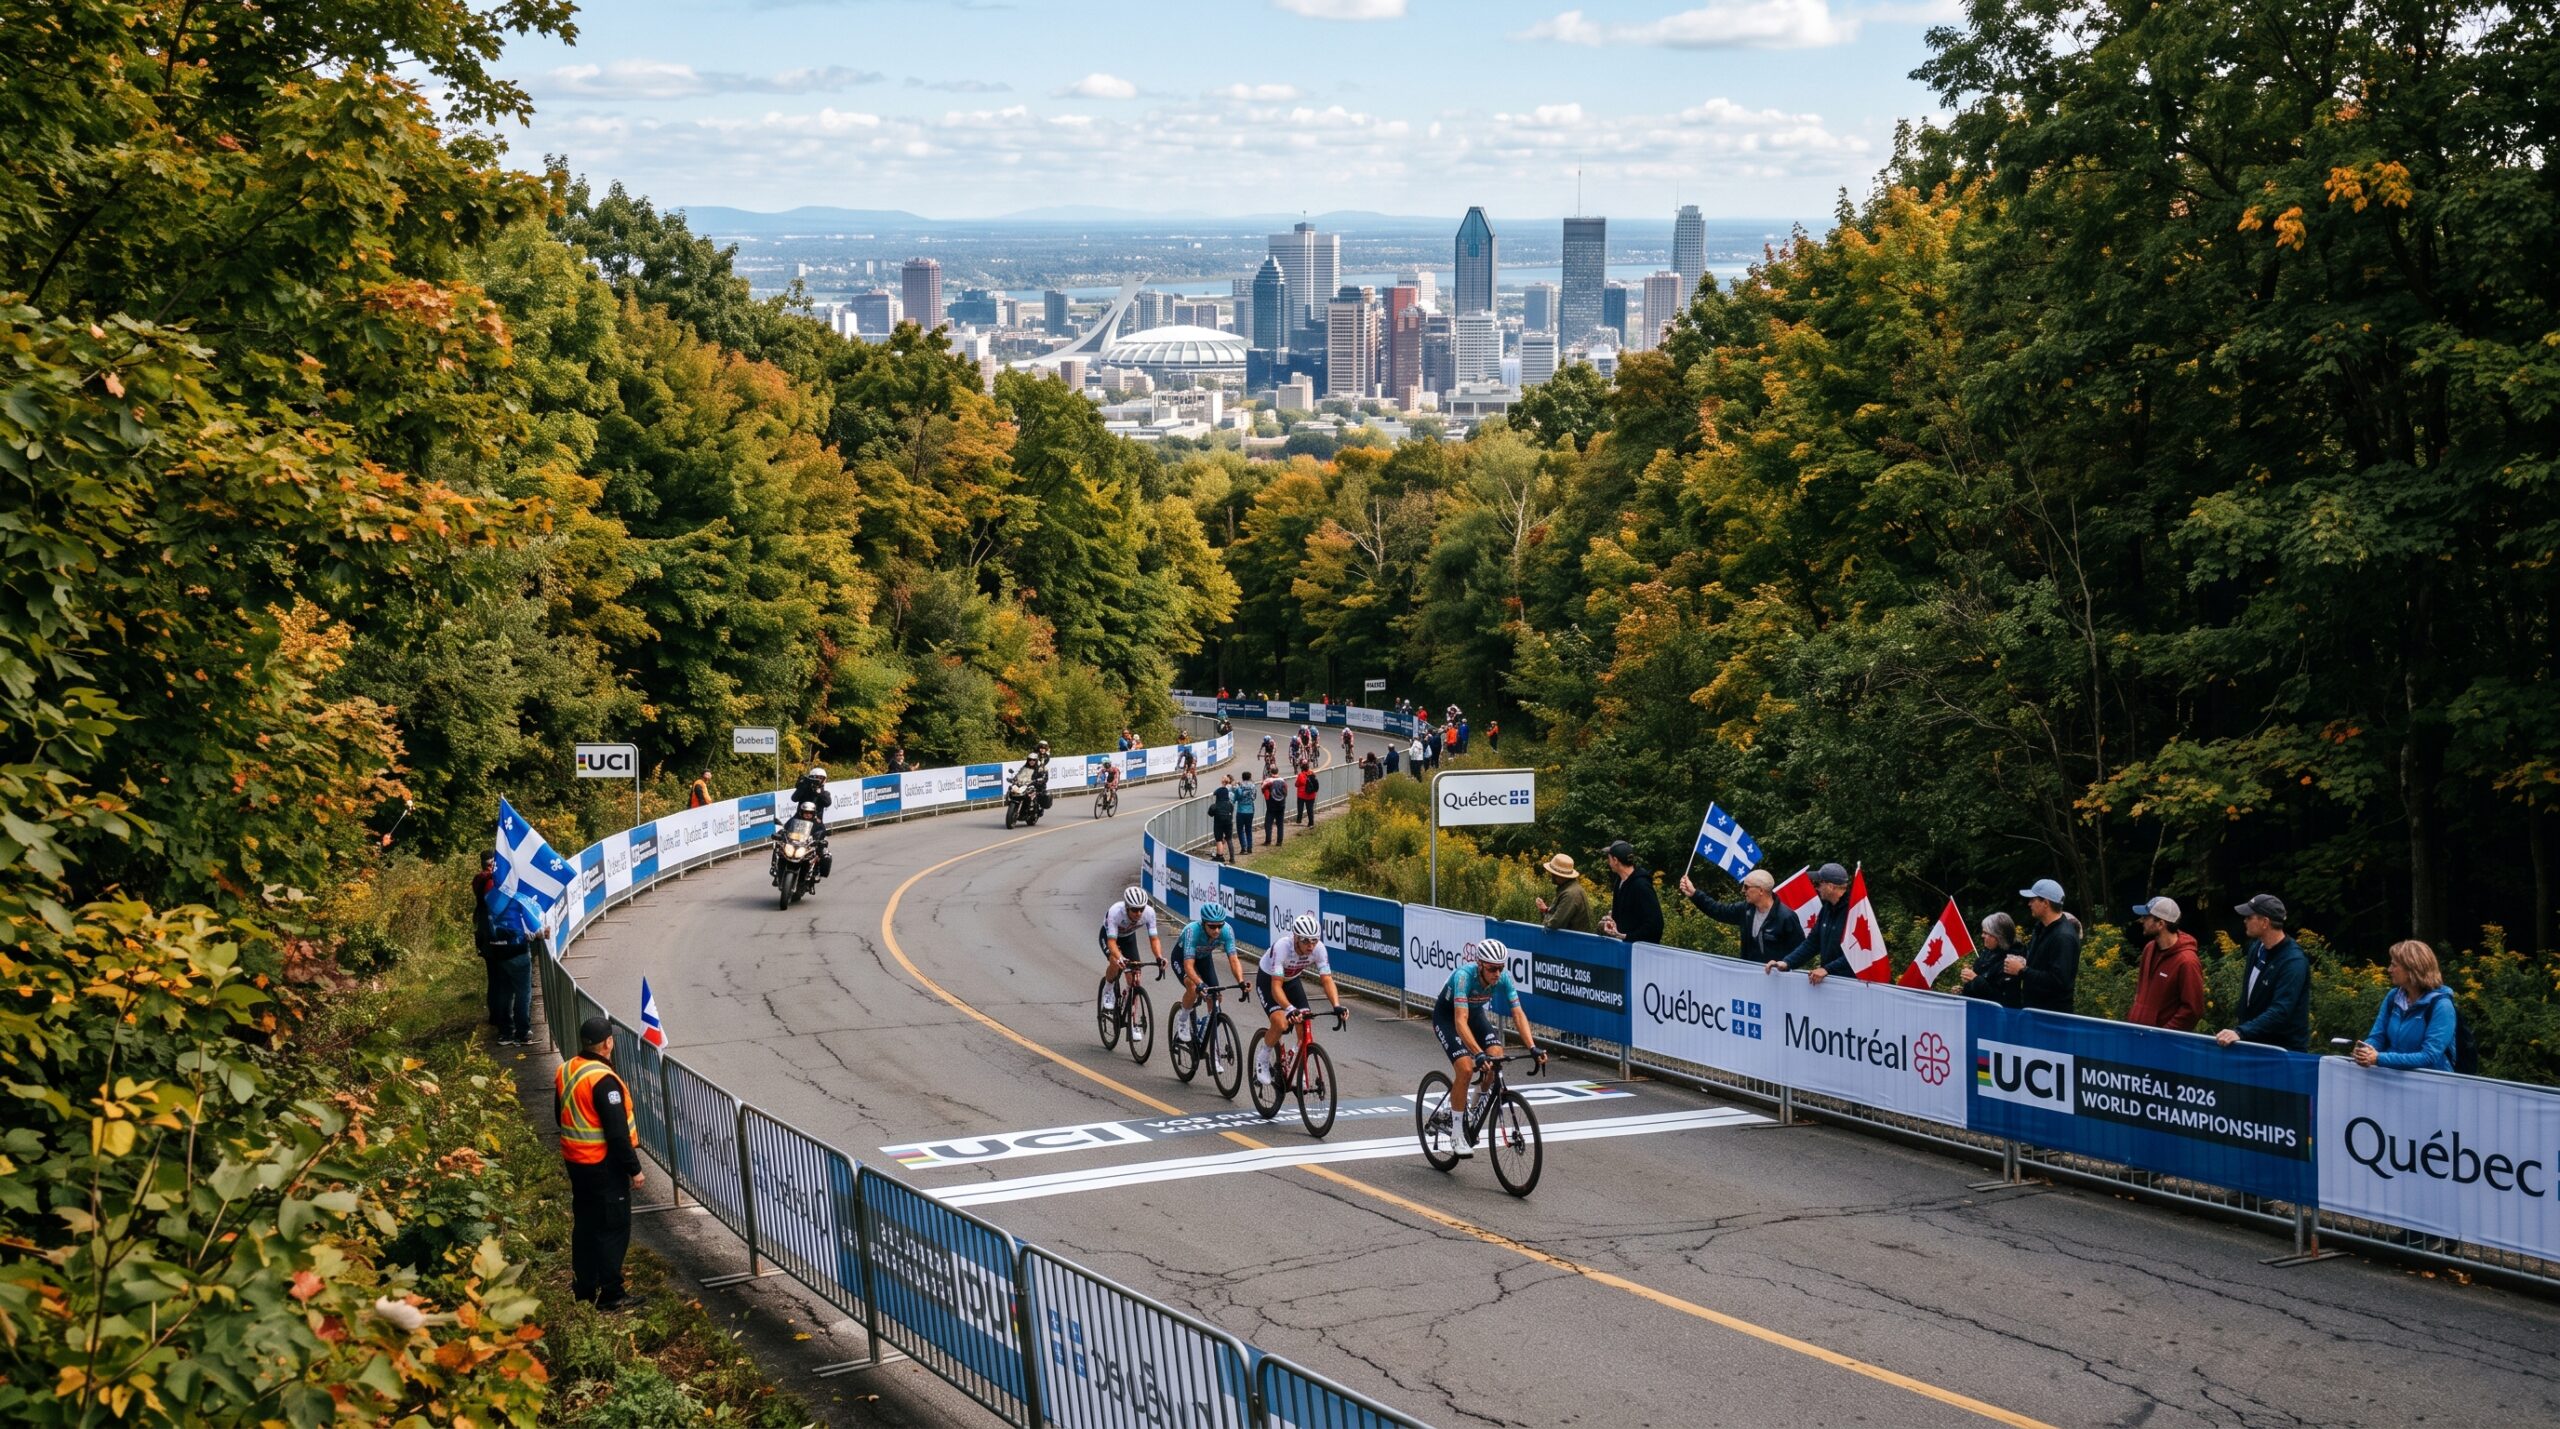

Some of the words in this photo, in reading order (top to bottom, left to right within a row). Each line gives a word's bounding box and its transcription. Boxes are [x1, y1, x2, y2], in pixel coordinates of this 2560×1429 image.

[588, 753, 630, 771] UCI
[1443, 791, 1508, 810] Québec
[1273, 905, 1294, 933] Québ
[1508, 957, 1529, 985] CI
[1534, 976, 1559, 993] WORLD
[1643, 982, 1728, 1032] Québec
[1785, 1012, 1907, 1071] Montréal
[1993, 1052, 2066, 1102] UCI
[2081, 1067, 2173, 1100] MONTRÉAL
[2176, 1085, 2216, 1107] 2026
[2081, 1090, 2141, 1116] WORLD
[2145, 1103, 2297, 1147] CHAMPIONSHIPS
[928, 1127, 1126, 1159] UCI
[2344, 1116, 2546, 1198] Québec
